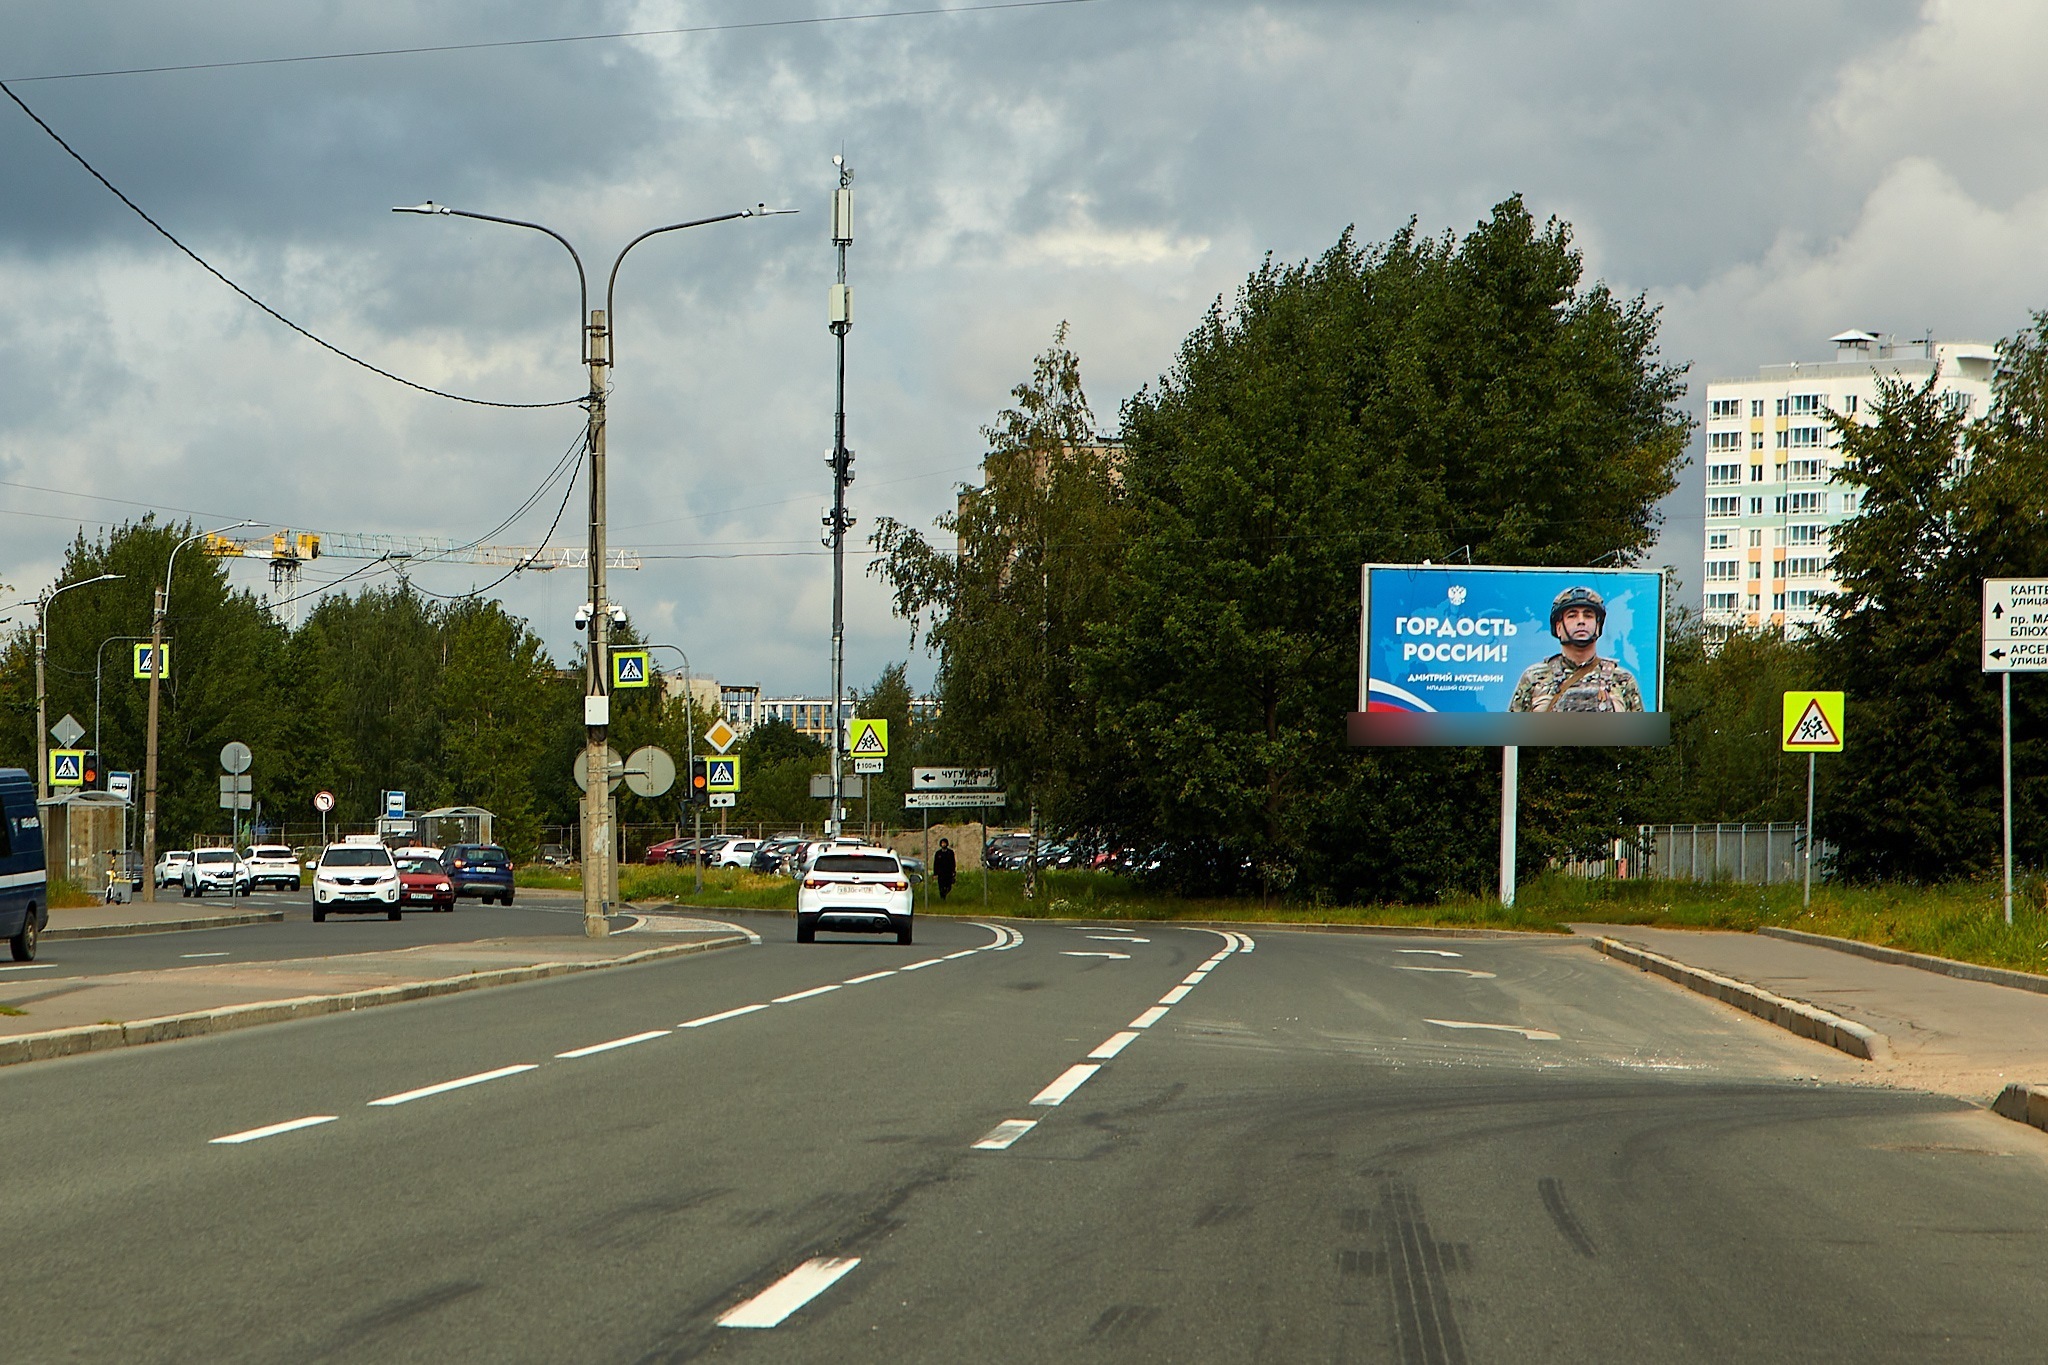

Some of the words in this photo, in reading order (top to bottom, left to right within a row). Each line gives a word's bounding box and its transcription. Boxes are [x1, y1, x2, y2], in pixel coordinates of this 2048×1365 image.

[2011, 597, 2048, 608] улица
[2010, 616, 2029, 626] пр.
[1395, 616, 1517, 639] ГОРДОСТЬ
[2010, 626, 2048, 636] БЛЮХ
[1403, 643, 1508, 664] РОССИИ!
[2010, 644, 2048, 654] АРСЕ
[2010, 657, 2047, 667] улица
[1407, 672, 1452, 683] ДМИТРИЙ
[1454, 674, 1504, 683] МУСТАФИН
